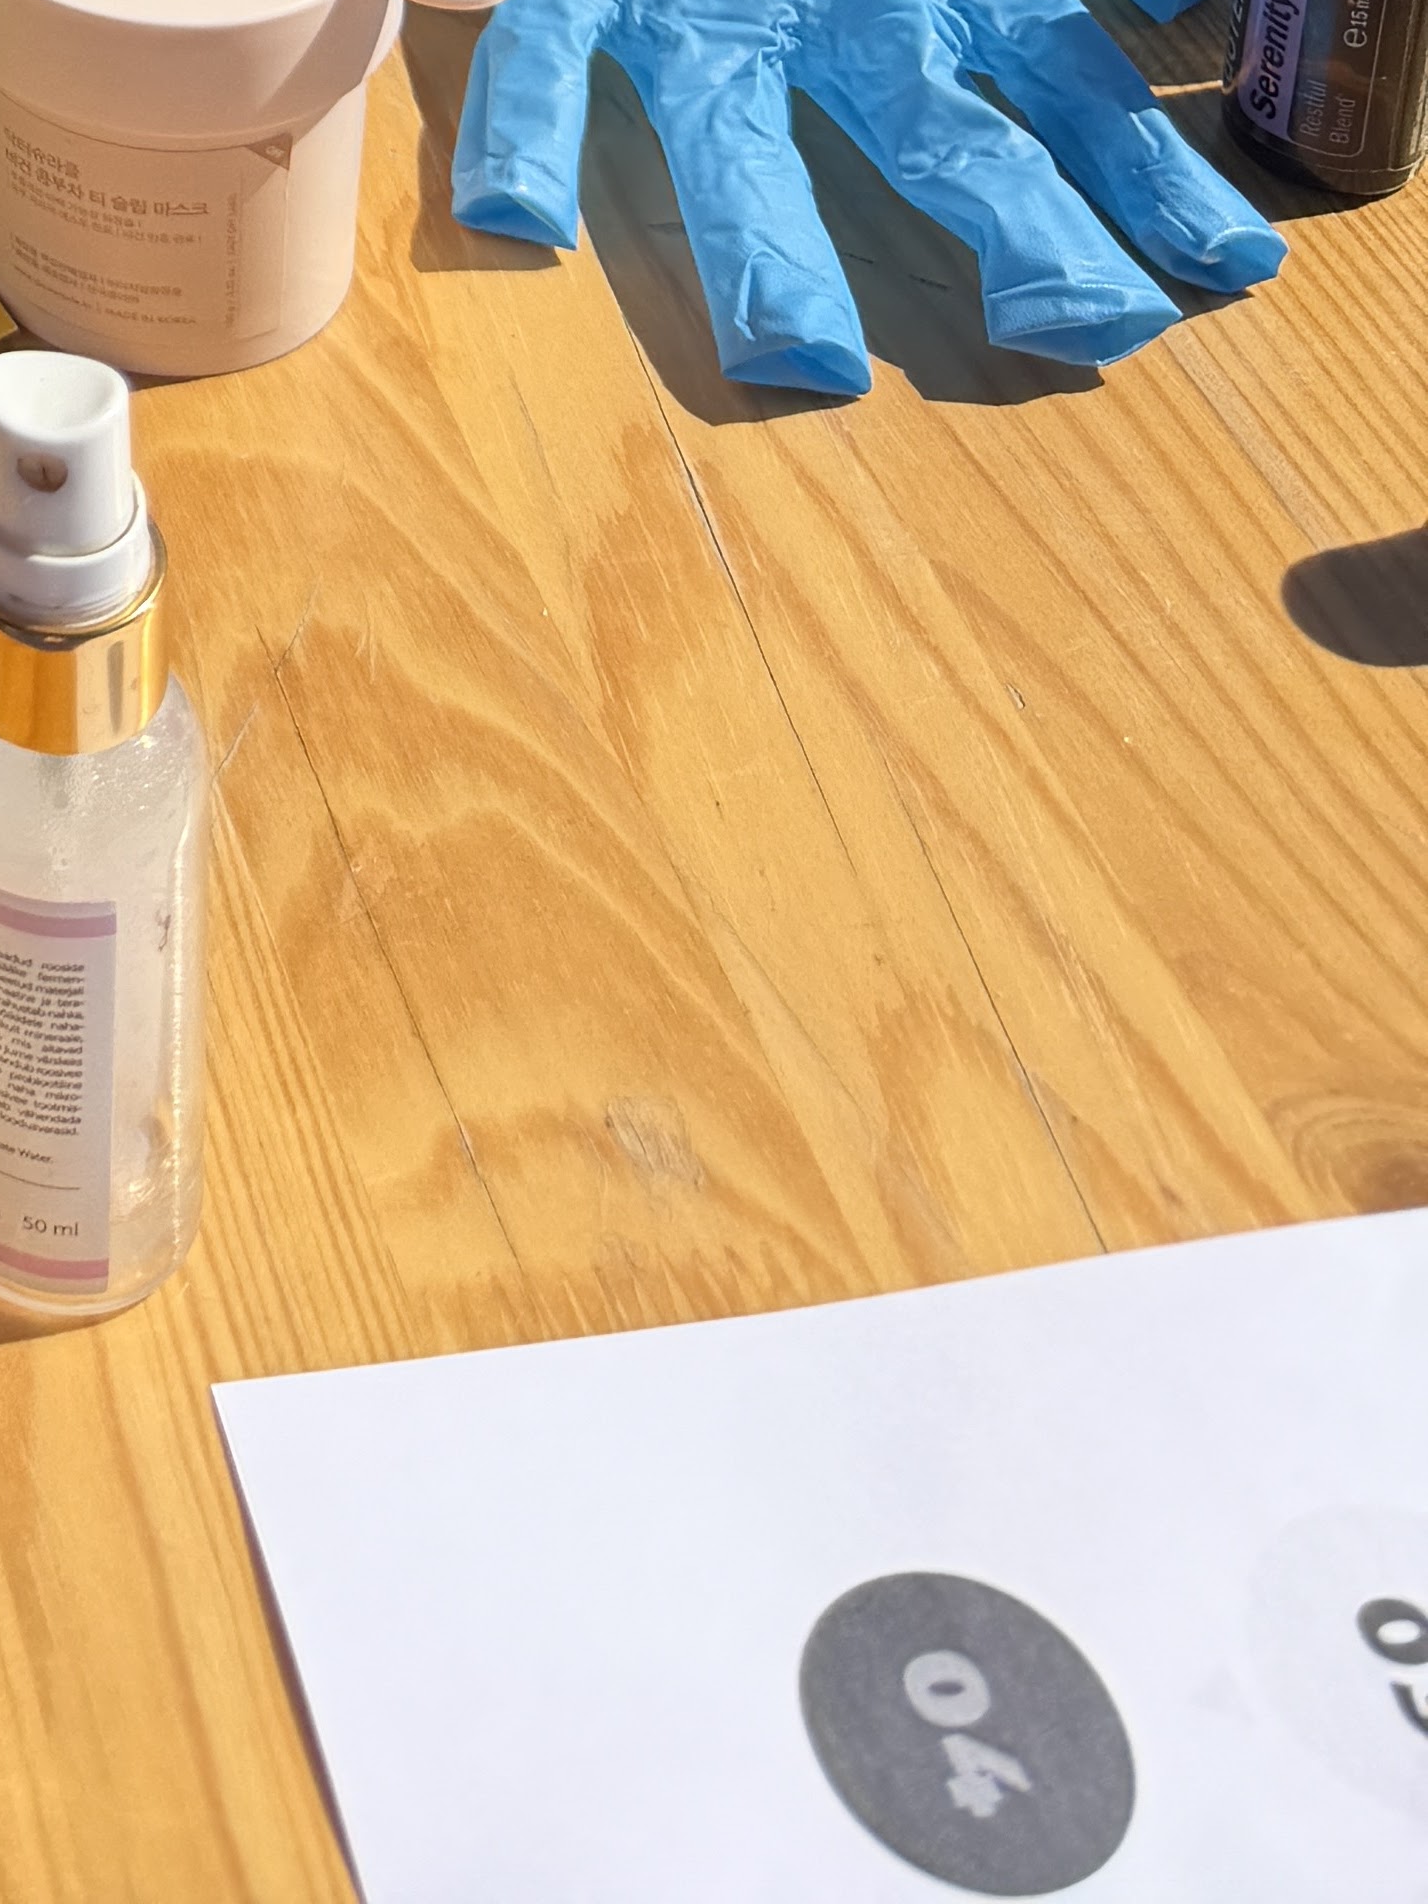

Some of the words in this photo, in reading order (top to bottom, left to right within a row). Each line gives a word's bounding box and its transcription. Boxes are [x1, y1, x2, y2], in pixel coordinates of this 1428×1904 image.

[1300, 79, 1329, 138] Restful
[1329, 95, 1357, 145] Blend
[153, 201, 209, 217] 마스크
[22, 1215, 48, 1234] 50
[53, 1222, 80, 1237] ml
